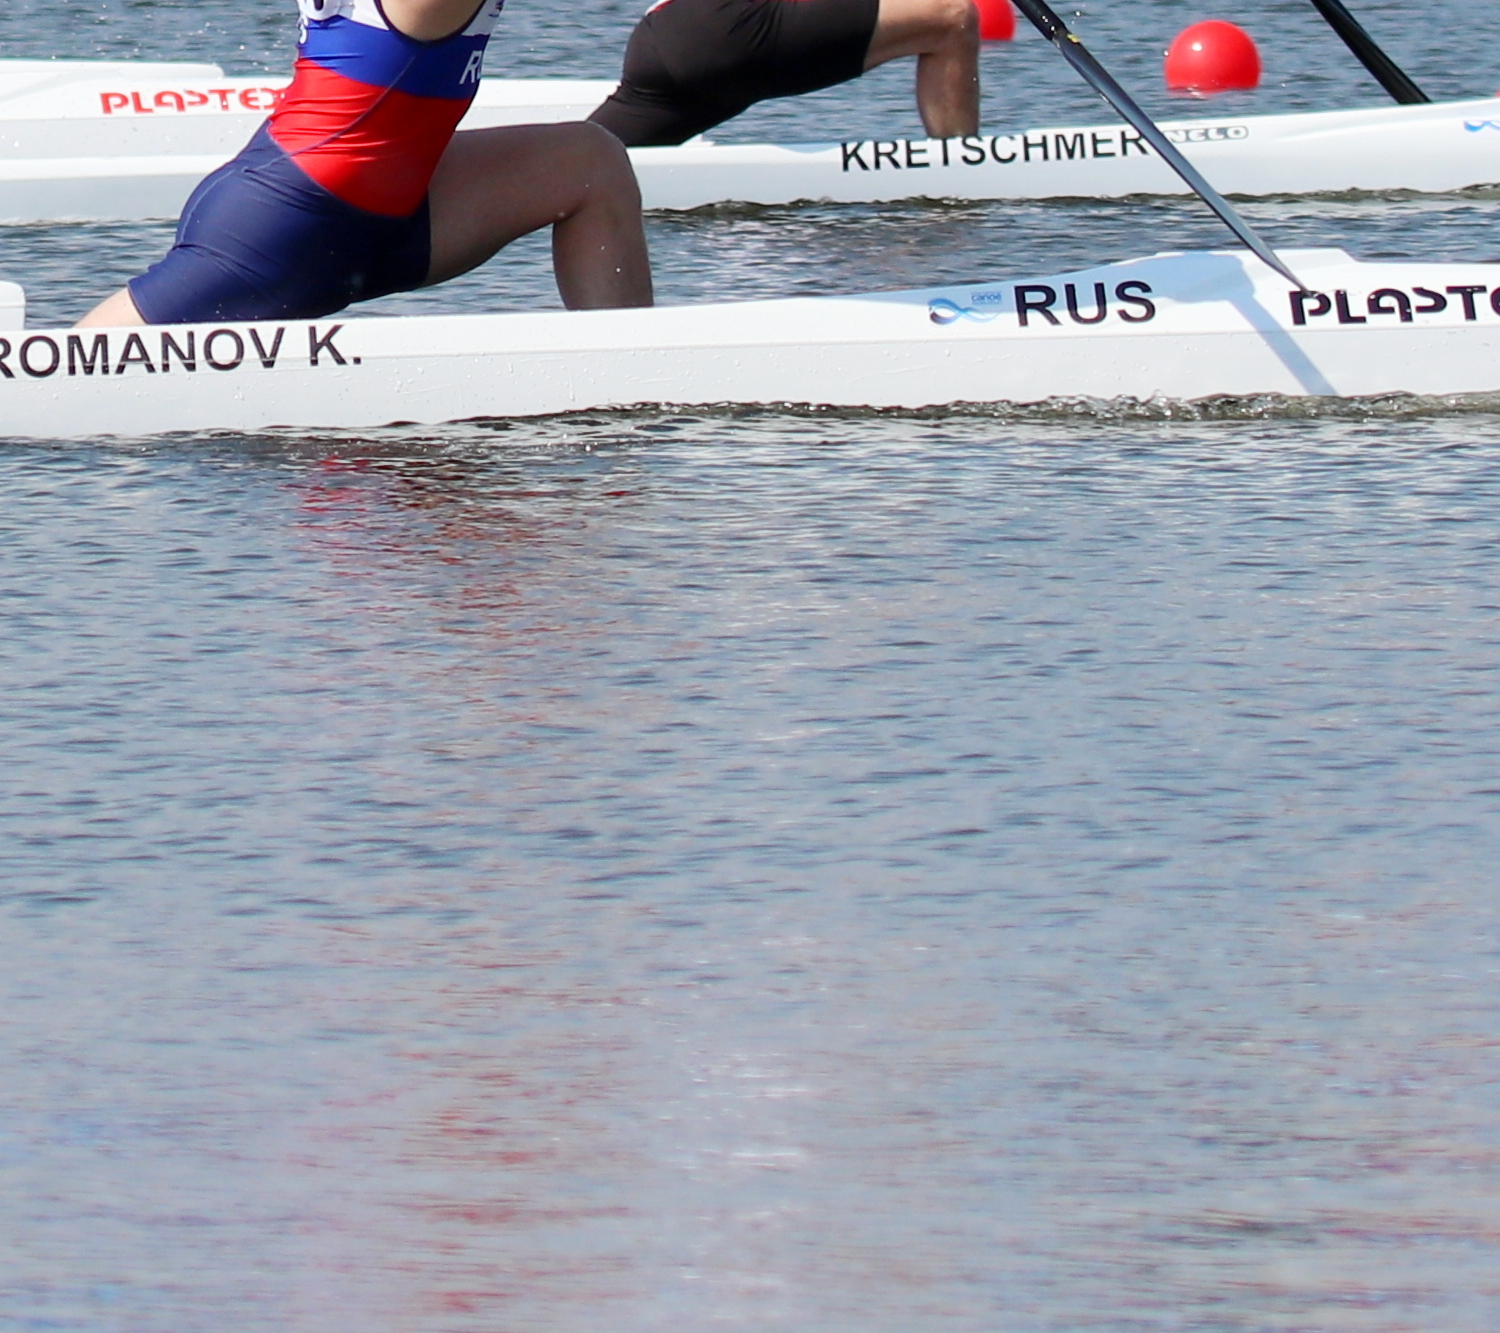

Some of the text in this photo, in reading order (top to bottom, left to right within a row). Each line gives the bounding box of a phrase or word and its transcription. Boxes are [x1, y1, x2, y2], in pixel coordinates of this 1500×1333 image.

[841, 130, 1150, 173] KRETSCHMER
[1013, 280, 1156, 327] RUS
[308, 324, 362, 367] K.
